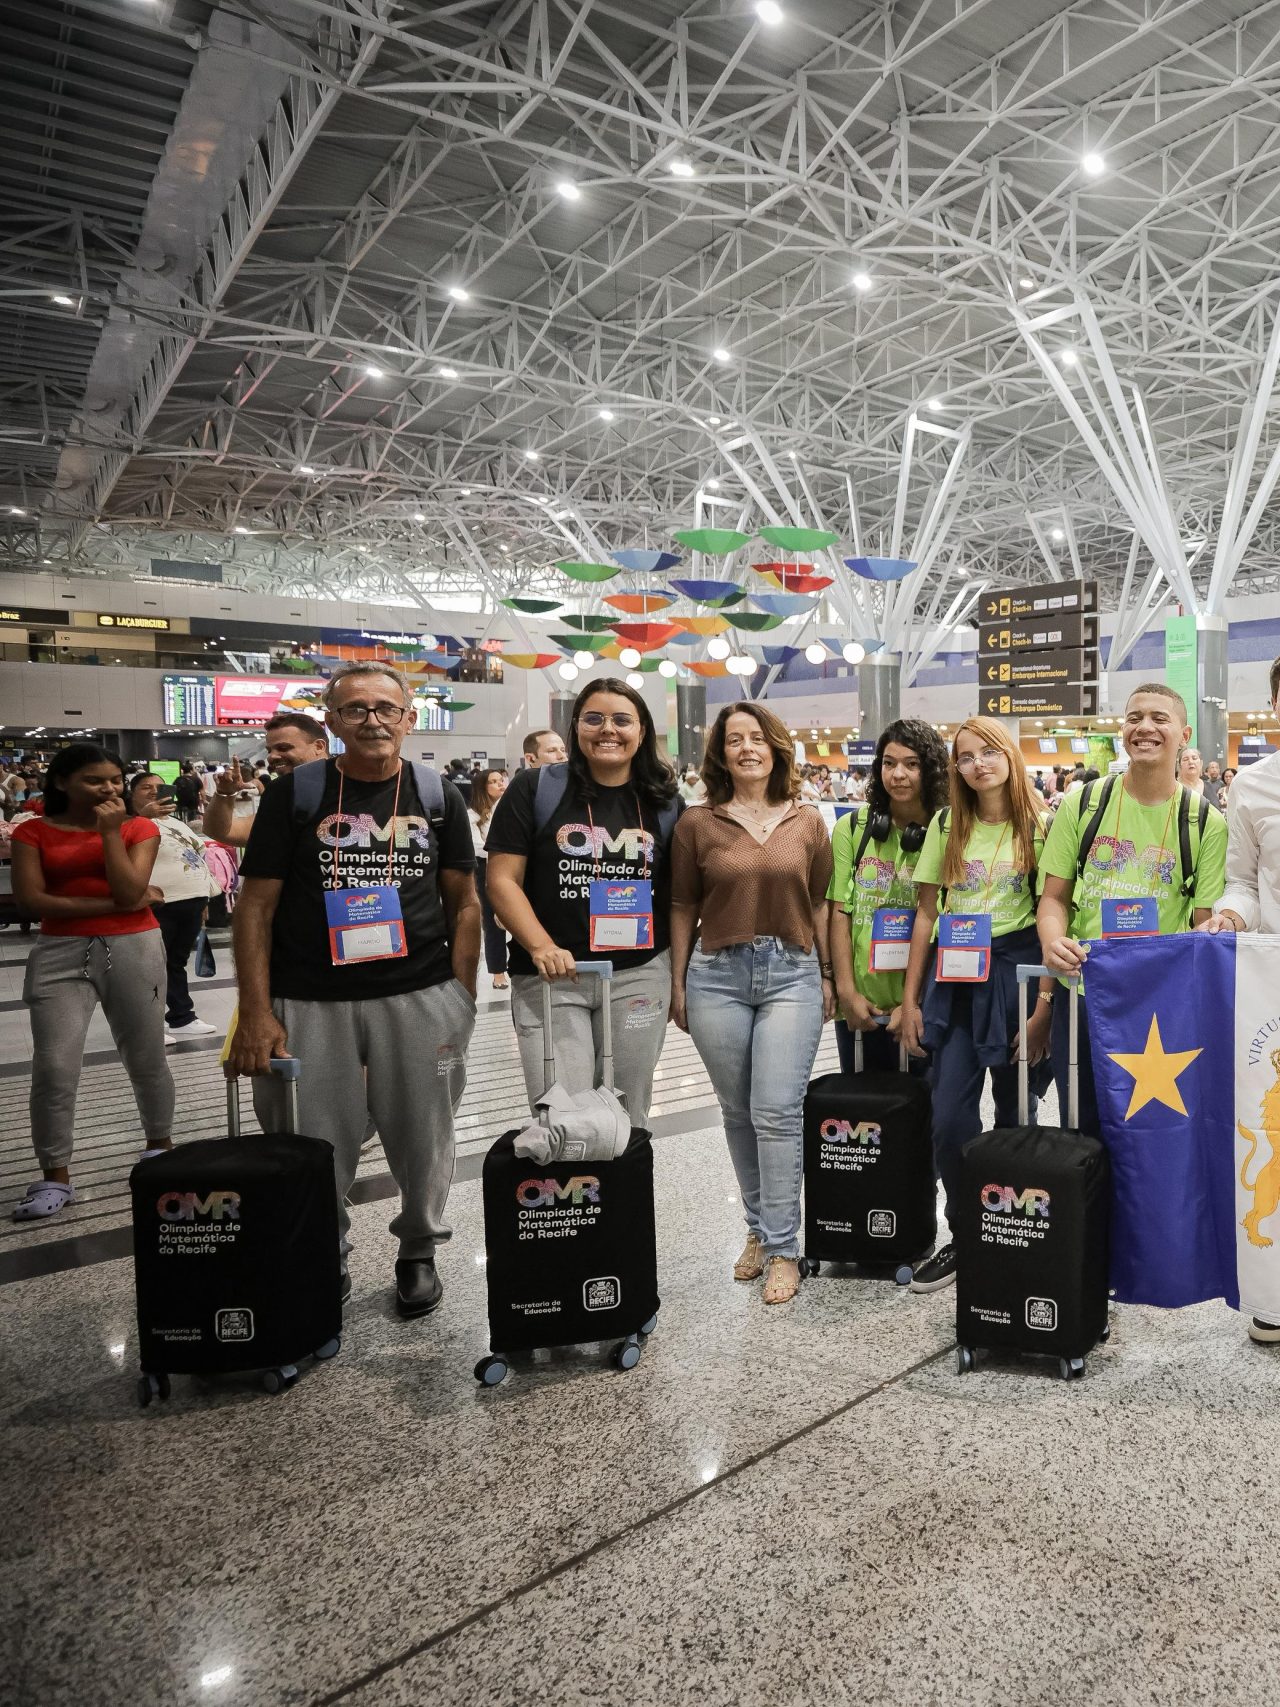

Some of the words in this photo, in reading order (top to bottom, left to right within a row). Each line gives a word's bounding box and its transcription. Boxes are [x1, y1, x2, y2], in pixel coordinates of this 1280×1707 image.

[1012, 605, 1031, 614] Check-in
[117, 617, 168, 628] LAÇABURGUER
[1012, 638, 1031, 646] Check-in
[1012, 672, 1035, 680] Embarque
[1036, 669, 1068, 678] Internacional
[317, 814, 429, 848] OMR
[557, 824, 654, 862] OMR
[319, 851, 408, 864] Olimpíada
[414, 853, 430, 864] de
[1088, 836, 1176, 884] OMR
[321, 865, 423, 877] Matemática
[559, 860, 634, 875] Olimpíada
[638, 867, 651, 876] de
[323, 878, 342, 889] do
[348, 877, 401, 888] Recife
[560, 888, 577, 898] do
[1153, 888, 1168, 899] de
[820, 1118, 882, 1144] OMR
[821, 1144, 867, 1155] Olimpíada
[869, 1146, 881, 1155] de
[821, 1153, 877, 1163] Matemática
[820, 1161, 832, 1169] do
[834, 1162, 863, 1171] Recife
[516, 1175, 600, 1208] OMR
[156, 1191, 241, 1221] OMR
[981, 1184, 1051, 1217] OMR
[518, 1206, 582, 1220] Olimpíada
[586, 1205, 601, 1215] de
[518, 1216, 596, 1230] Matemática
[982, 1212, 1034, 1228] Olimpíada
[1036, 1219, 1049, 1229] de
[159, 1223, 221, 1235] Olimpíada
[225, 1222, 241, 1231] de
[518, 1230, 534, 1240] do
[538, 1228, 578, 1240] Recife
[871, 1225, 892, 1233] RECIFE
[982, 1222, 1044, 1239] Matemática
[159, 1233, 235, 1244] Matemática
[981, 1233, 994, 1243] do
[996, 1234, 1029, 1248] Recife
[159, 1245, 173, 1255] do
[177, 1244, 216, 1254] Recife
[511, 1301, 550, 1309] Secretaria
[590, 1296, 615, 1305] RECIFE
[524, 1306, 562, 1315] Educação
[970, 1306, 1001, 1317] Secretaria
[1030, 1316, 1052, 1325] RECIFE
[221, 1328, 248, 1336] RECIFE
